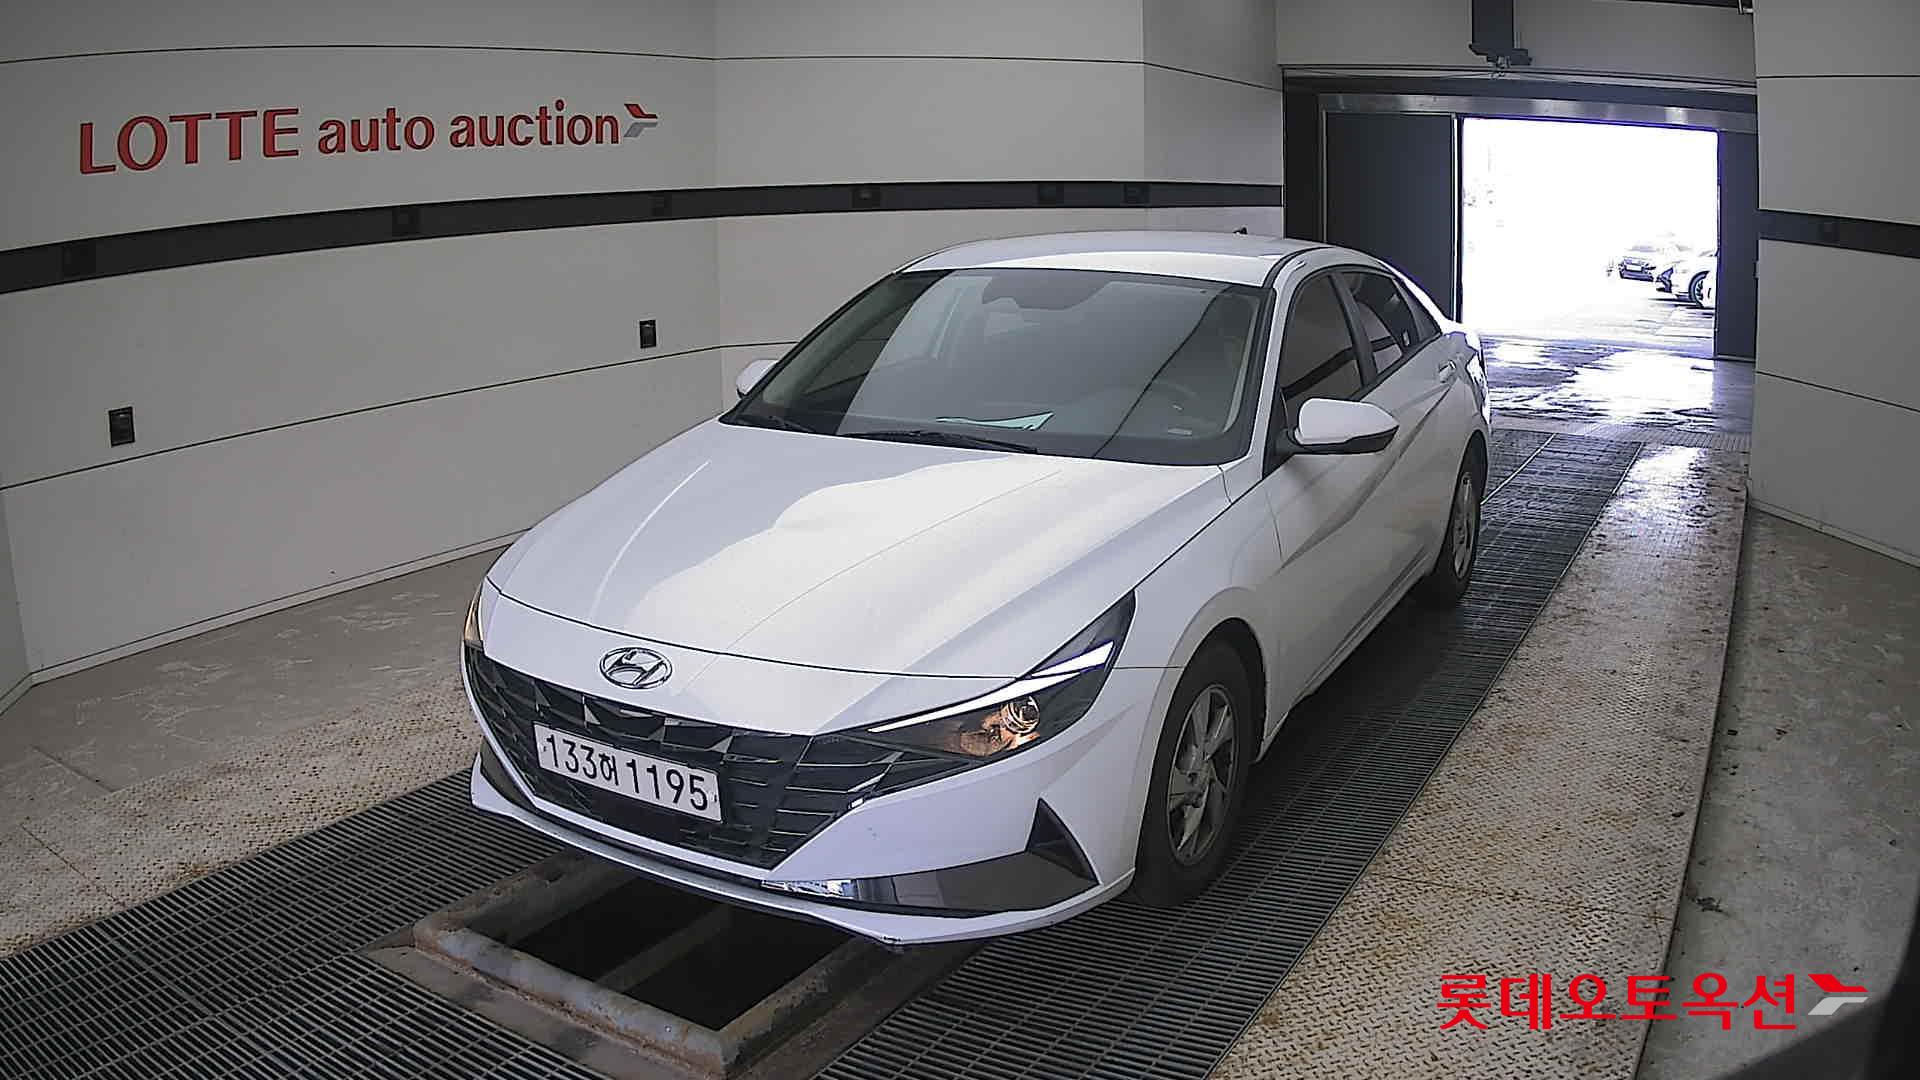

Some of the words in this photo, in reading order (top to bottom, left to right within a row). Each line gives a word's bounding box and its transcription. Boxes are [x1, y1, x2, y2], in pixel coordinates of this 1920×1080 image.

[79, 108, 299, 174] LOTTE
[317, 107, 435, 154] auto
[449, 99, 620, 148] auction
